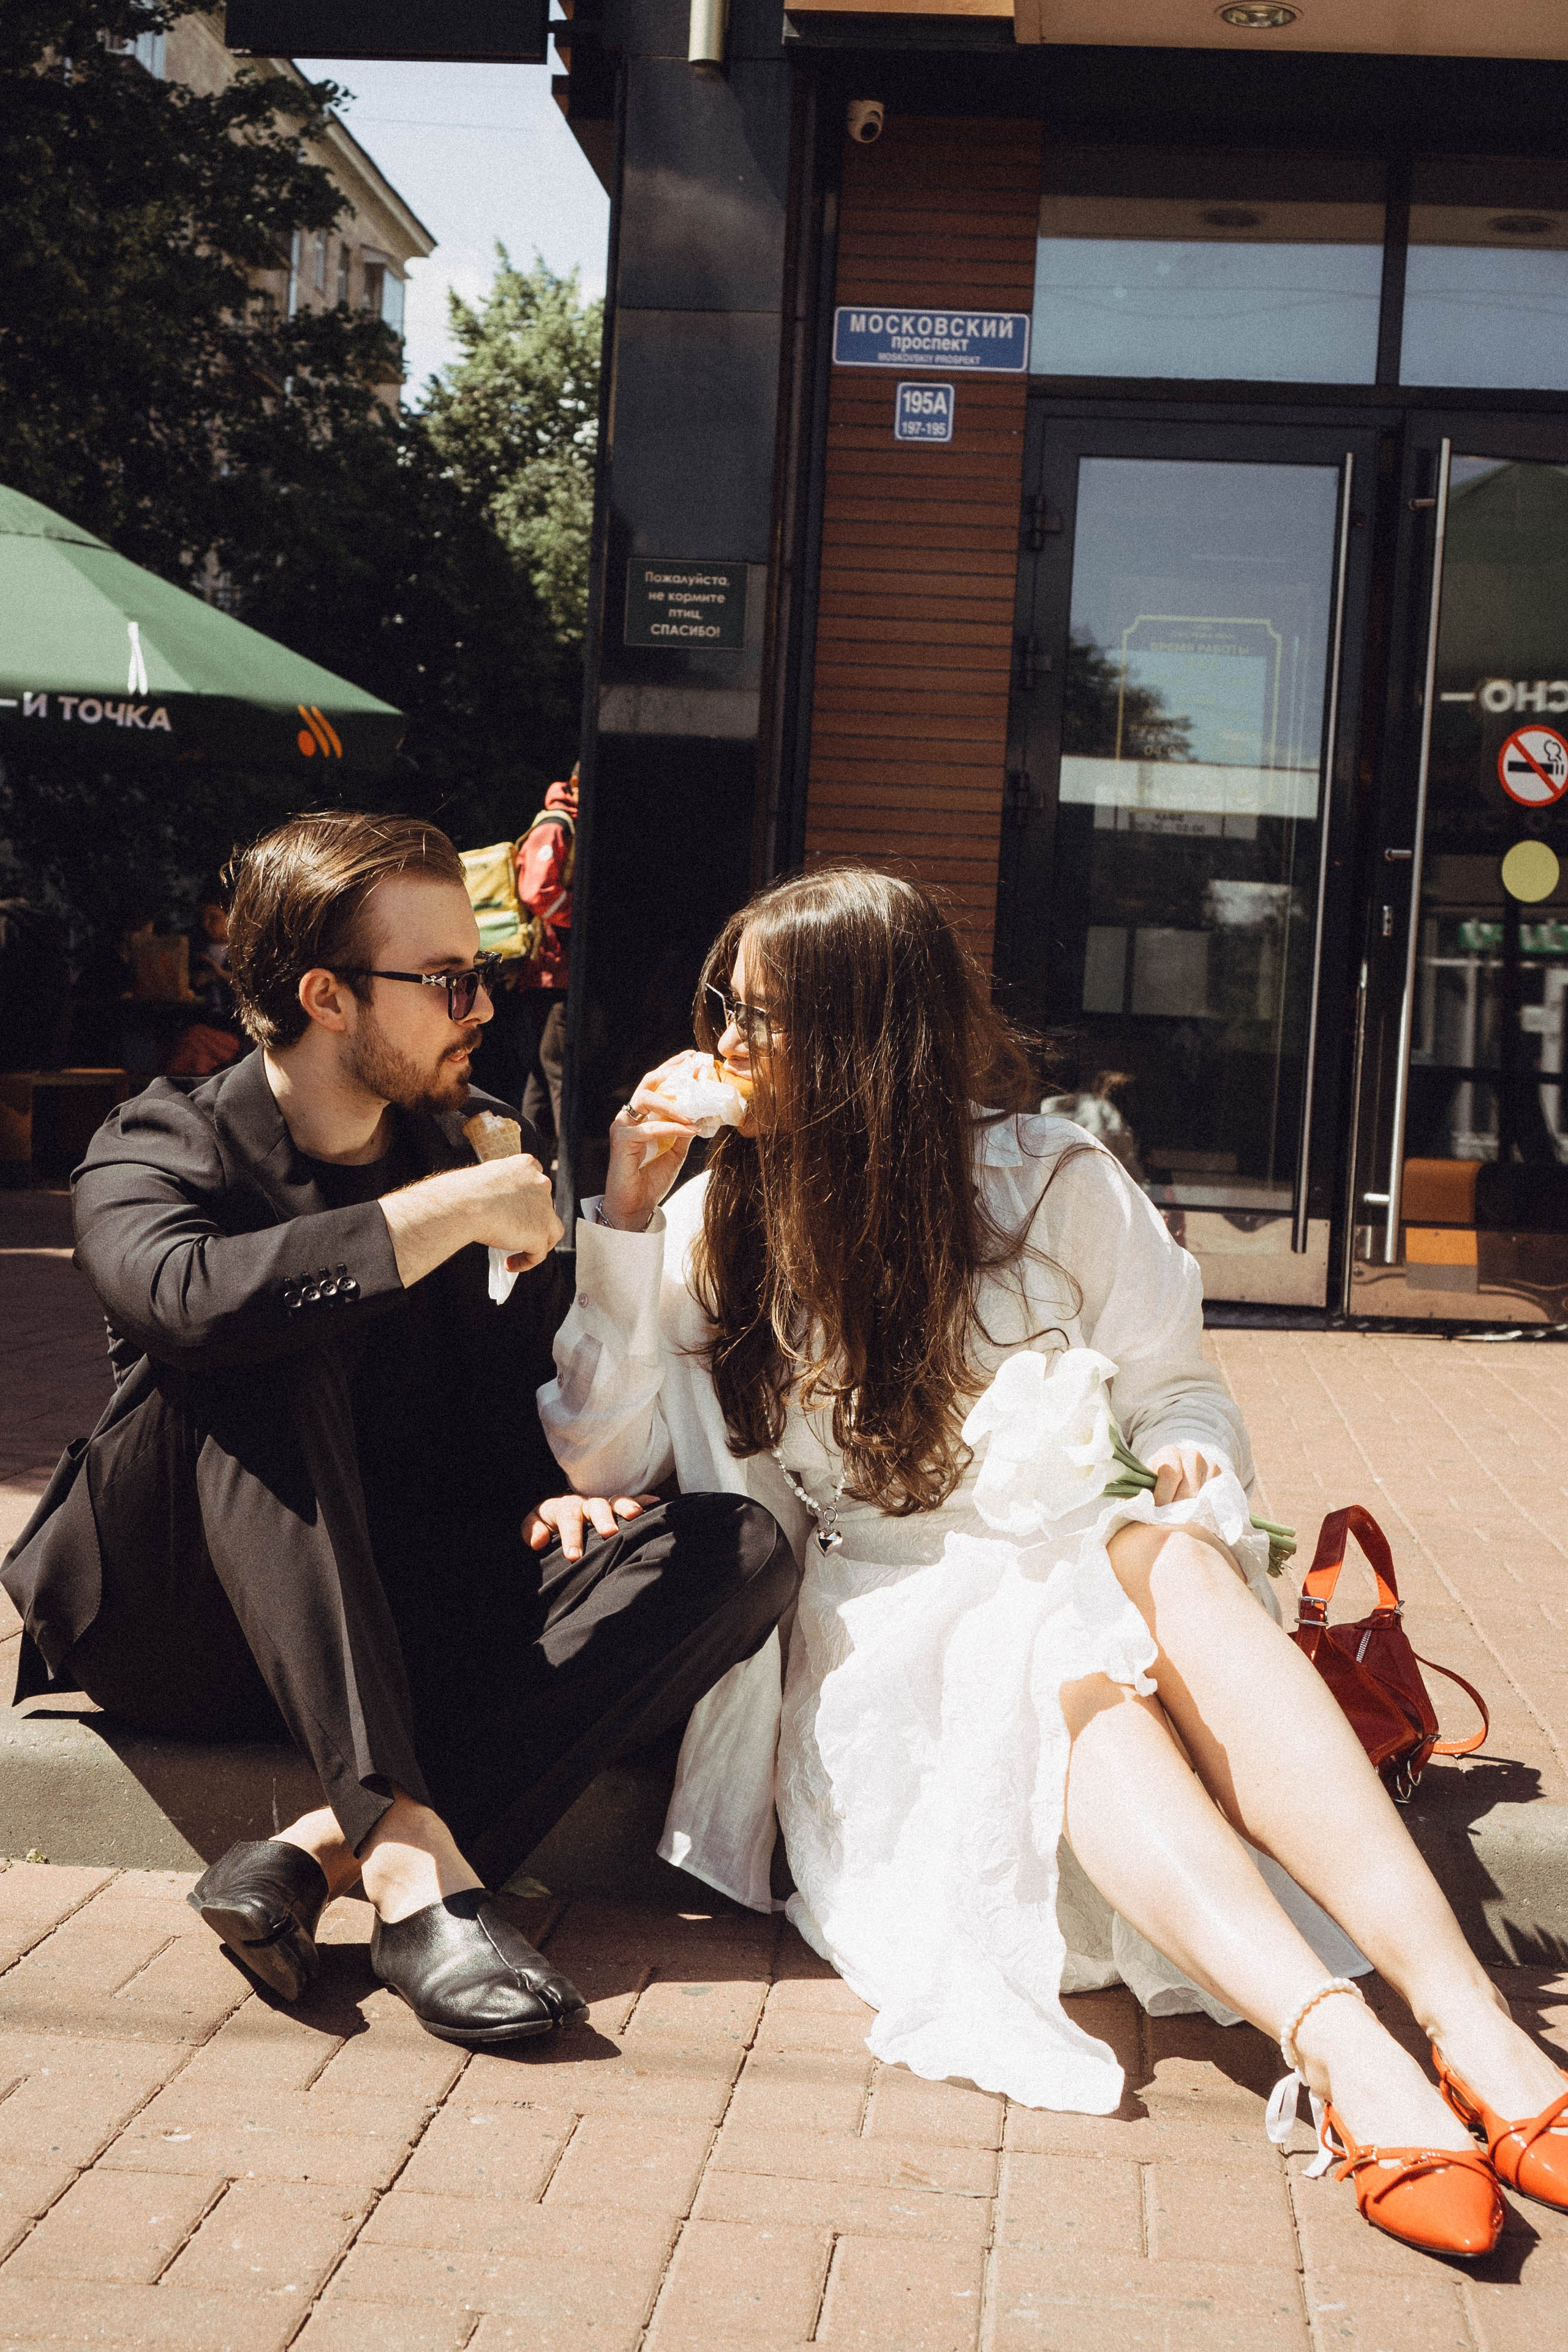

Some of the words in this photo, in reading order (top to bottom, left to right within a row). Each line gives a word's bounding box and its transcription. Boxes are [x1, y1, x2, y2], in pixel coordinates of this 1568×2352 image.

[850, 314, 1014, 339] МОСКОВСКИЙ
[891, 336, 970, 352] проспект
[903, 390, 948, 415] 195А
[648, 592, 665, 601] не
[668, 592, 726, 604] кормите
[650, 624, 721, 638] СПАСИБО!
[23, 691, 48, 718] И
[58, 695, 172, 732] ТОЧКА
